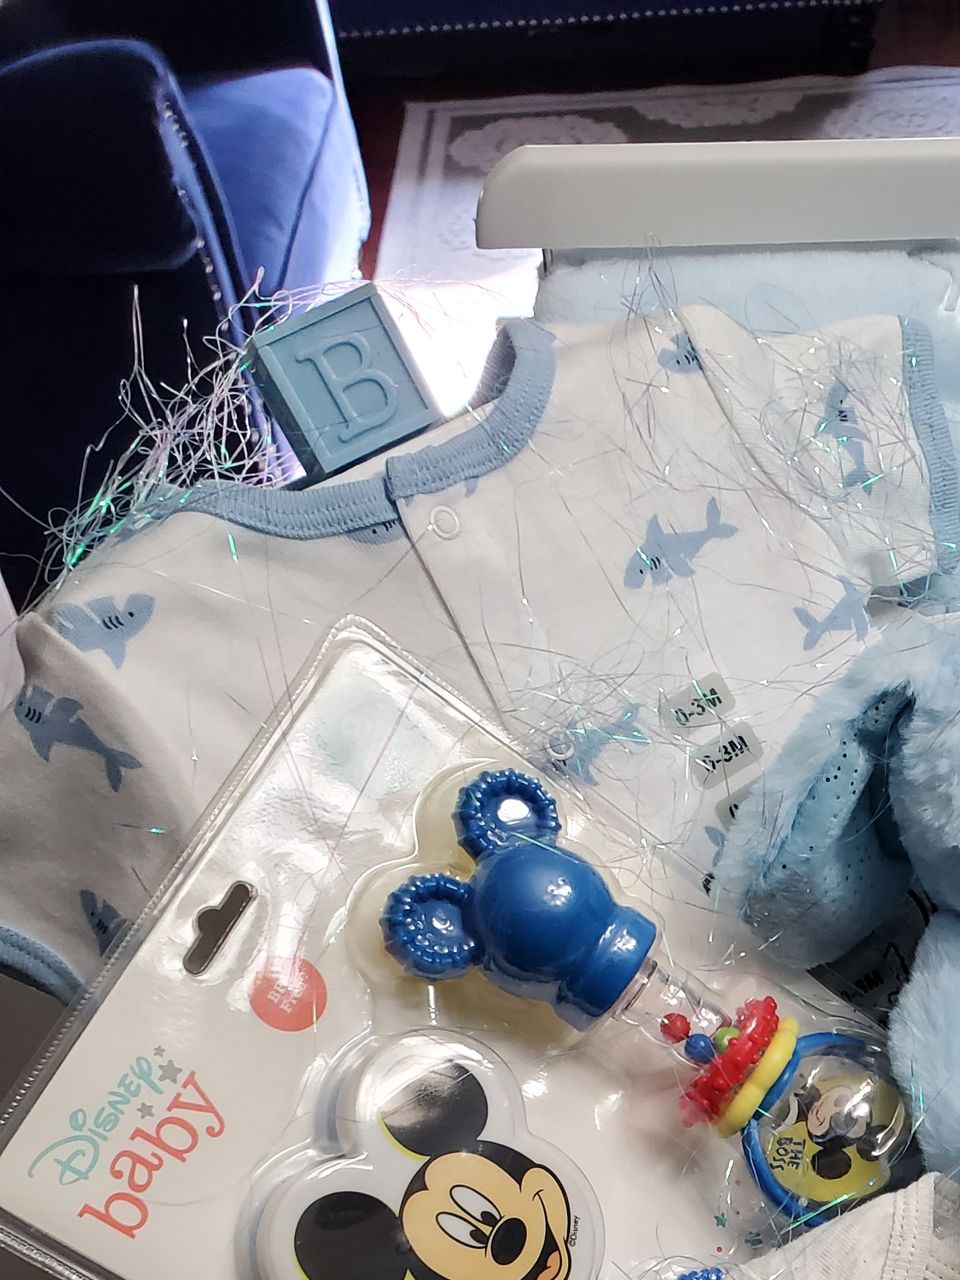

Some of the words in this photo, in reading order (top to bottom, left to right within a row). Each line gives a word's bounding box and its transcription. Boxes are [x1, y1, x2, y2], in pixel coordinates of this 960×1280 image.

[296, 332, 398, 443] B
[675, 687, 723, 726] 0-3M
[702, 735, 750, 773] 0-3M
[28, 1056, 165, 1186] Disney
[77, 1070, 226, 1240] baby
[770, 1136, 793, 1172] BOSS
[786, 1138, 807, 1171] THE
